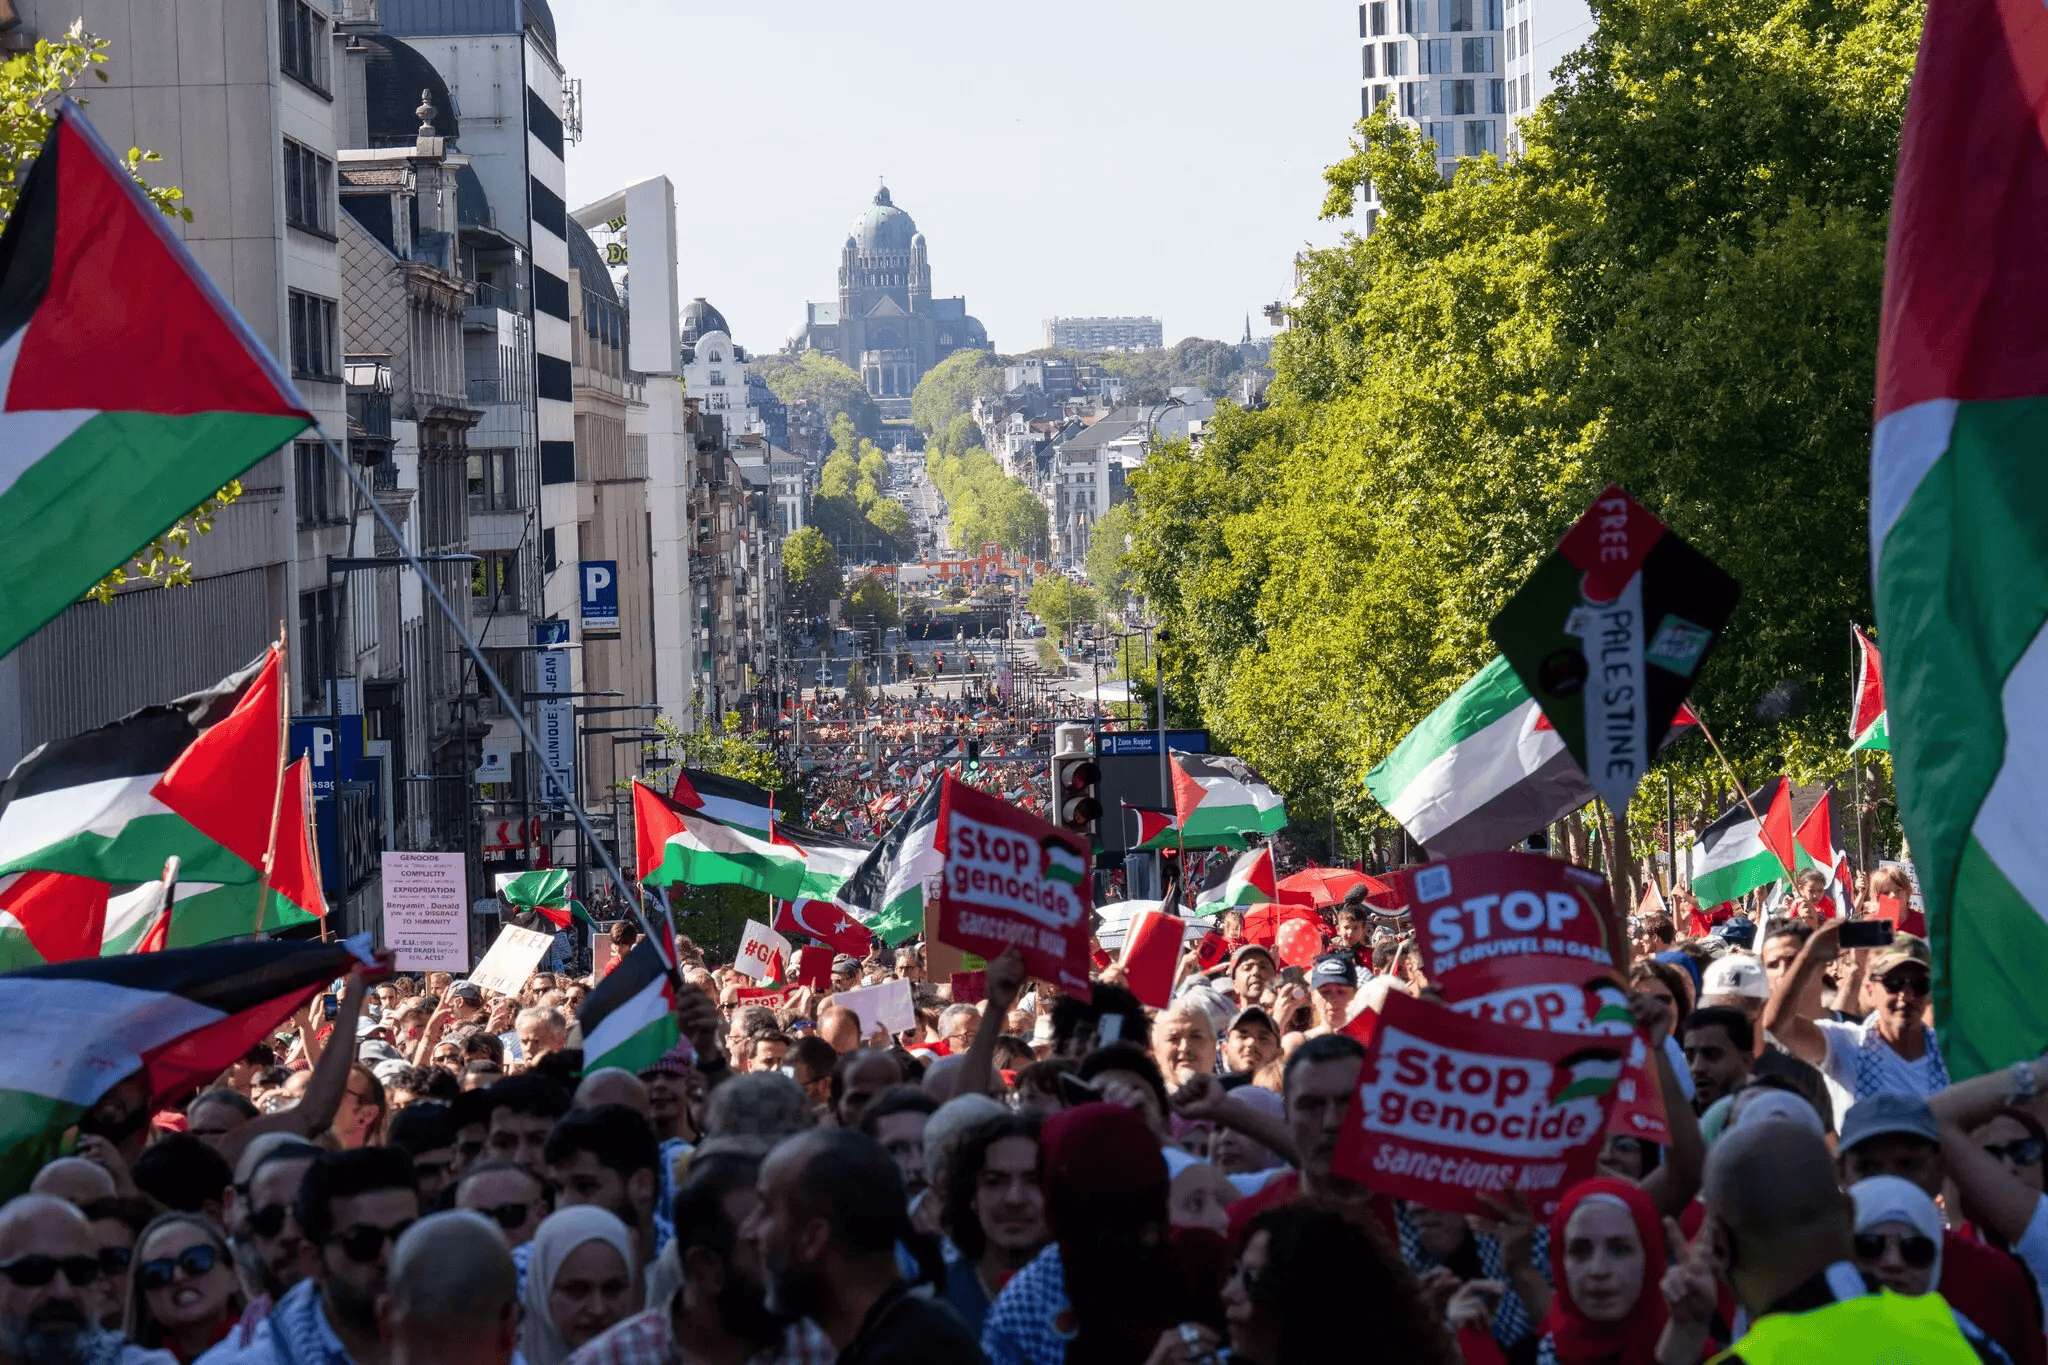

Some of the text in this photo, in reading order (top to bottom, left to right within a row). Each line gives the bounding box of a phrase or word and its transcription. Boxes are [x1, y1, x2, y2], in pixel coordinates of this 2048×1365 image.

[1598, 498, 1628, 563] FREE
[587, 567, 610, 601] P
[545, 657, 559, 768] CLINIQUE S-JEAN
[1600, 610, 1634, 780] PALESTINE
[313, 727, 341, 766] P
[1117, 738, 1132, 746] Zone
[1133, 738, 1152, 747] Rogier
[431, 902, 460, 910] Donald
[954, 864, 1070, 918] genocide
[1428, 890, 1579, 953] STOP
[1434, 937, 1613, 975] DE GRUWEL IN GAZA
[1473, 992, 1566, 1030] top
[1394, 1046, 1529, 1109] Stop
[1376, 1088, 1586, 1142] genocide
